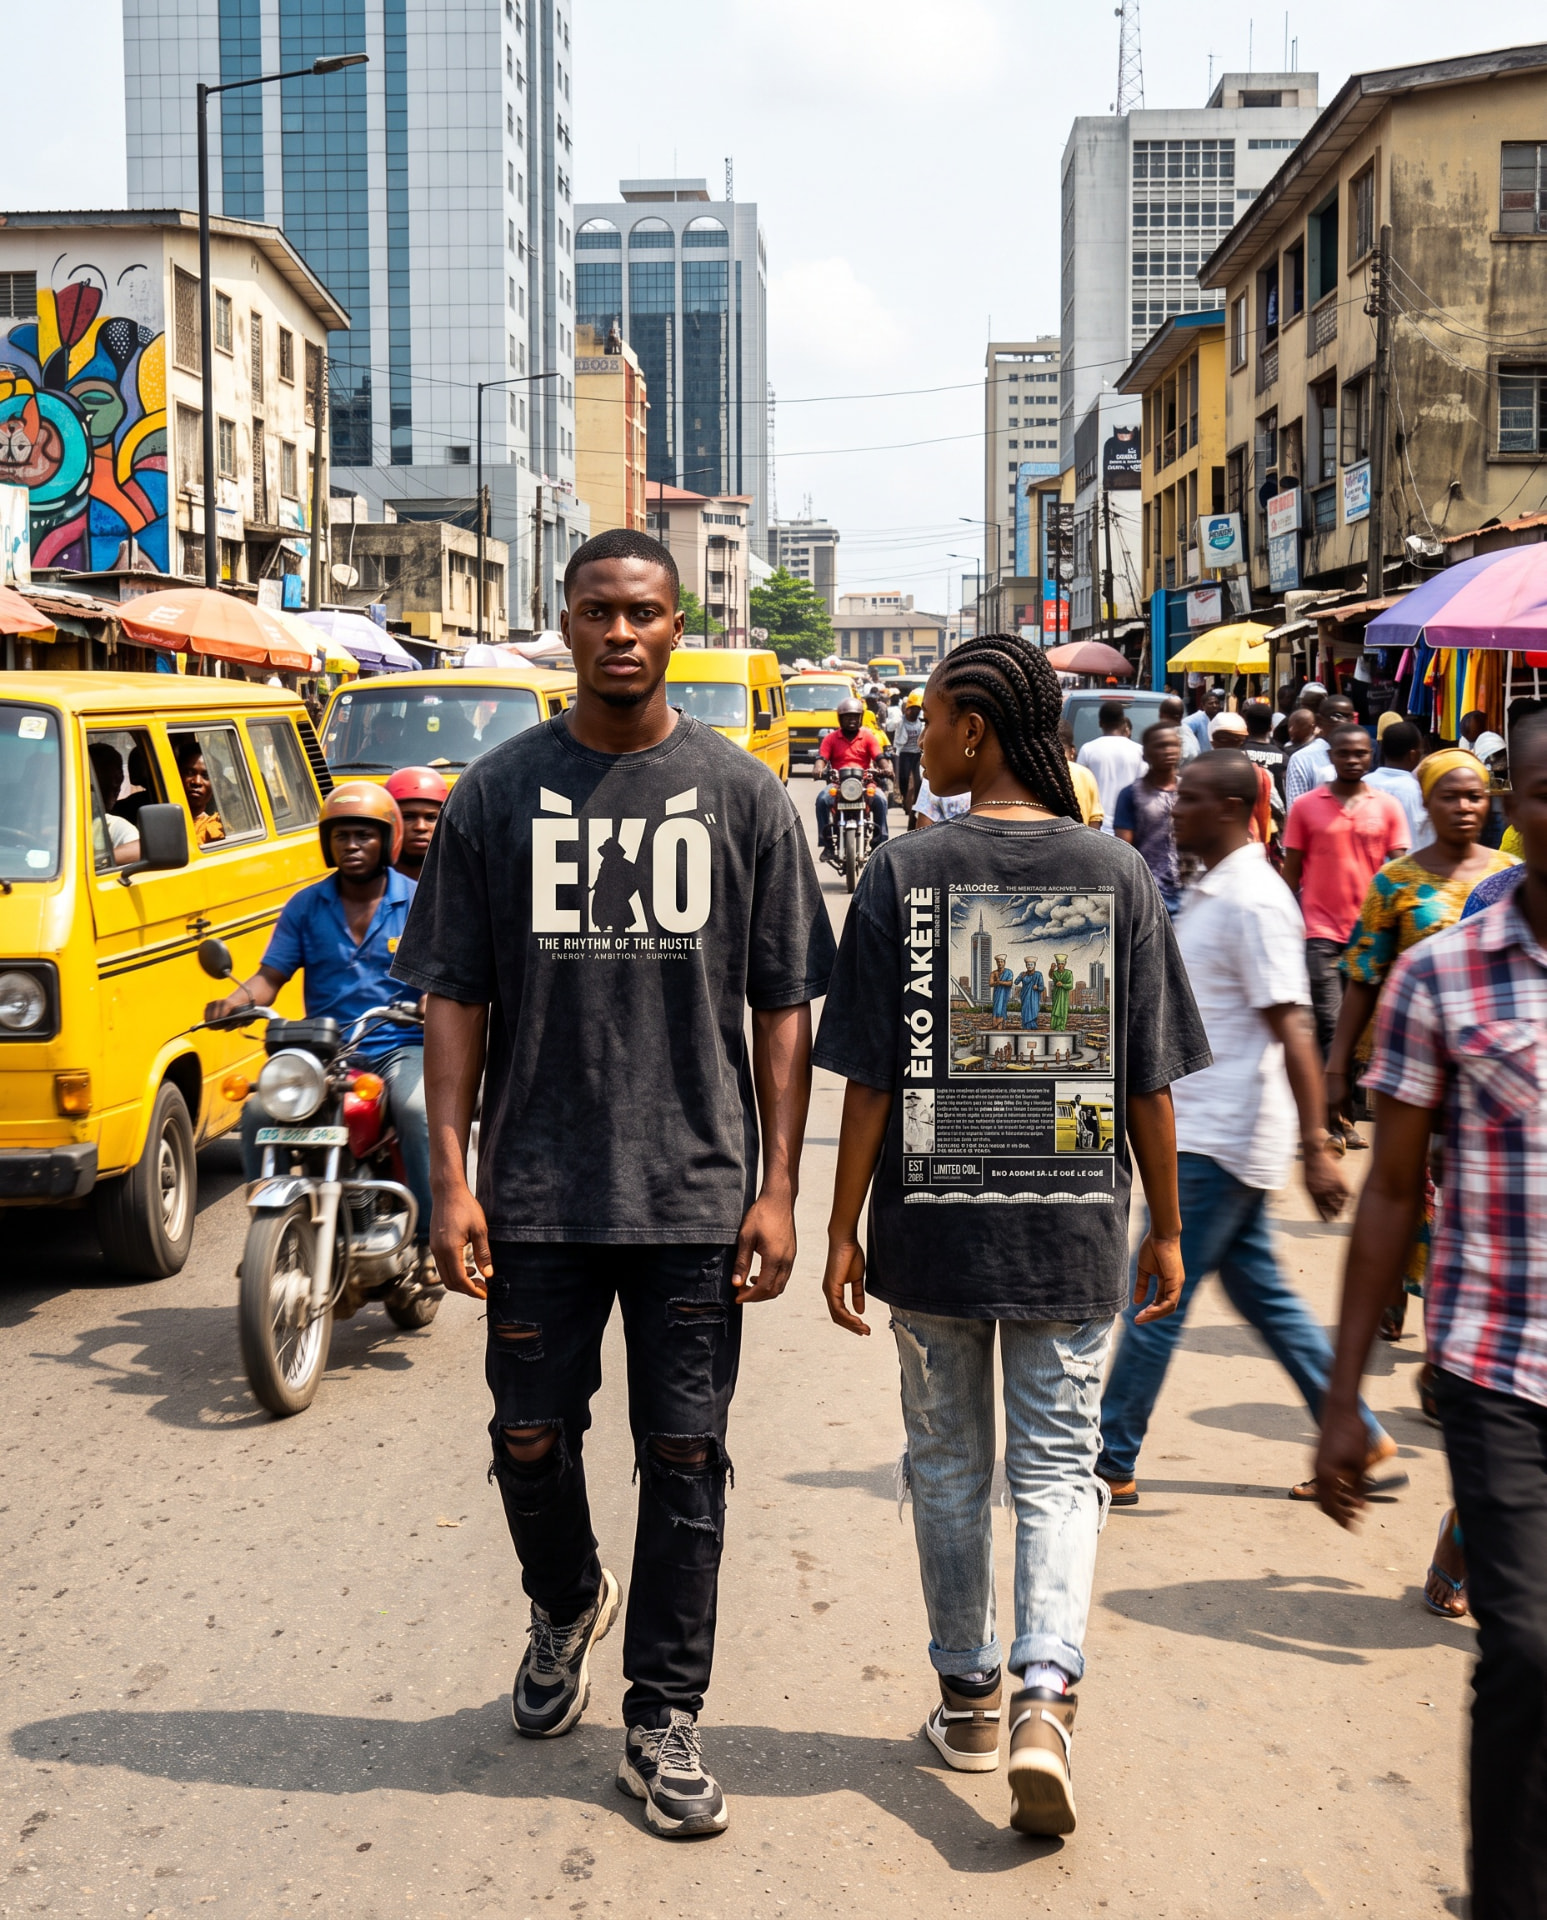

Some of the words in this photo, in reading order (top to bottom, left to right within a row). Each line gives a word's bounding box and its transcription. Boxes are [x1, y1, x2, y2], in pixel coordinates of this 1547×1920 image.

[538, 938, 560, 950] THE
[564, 938, 611, 950] RHYTHM
[615, 938, 630, 950] OF
[633, 938, 656, 950] THE
[659, 938, 703, 950] HUSTLE
[908, 1160, 924, 1172] EST
[933, 1164, 961, 1175] LIMITED
